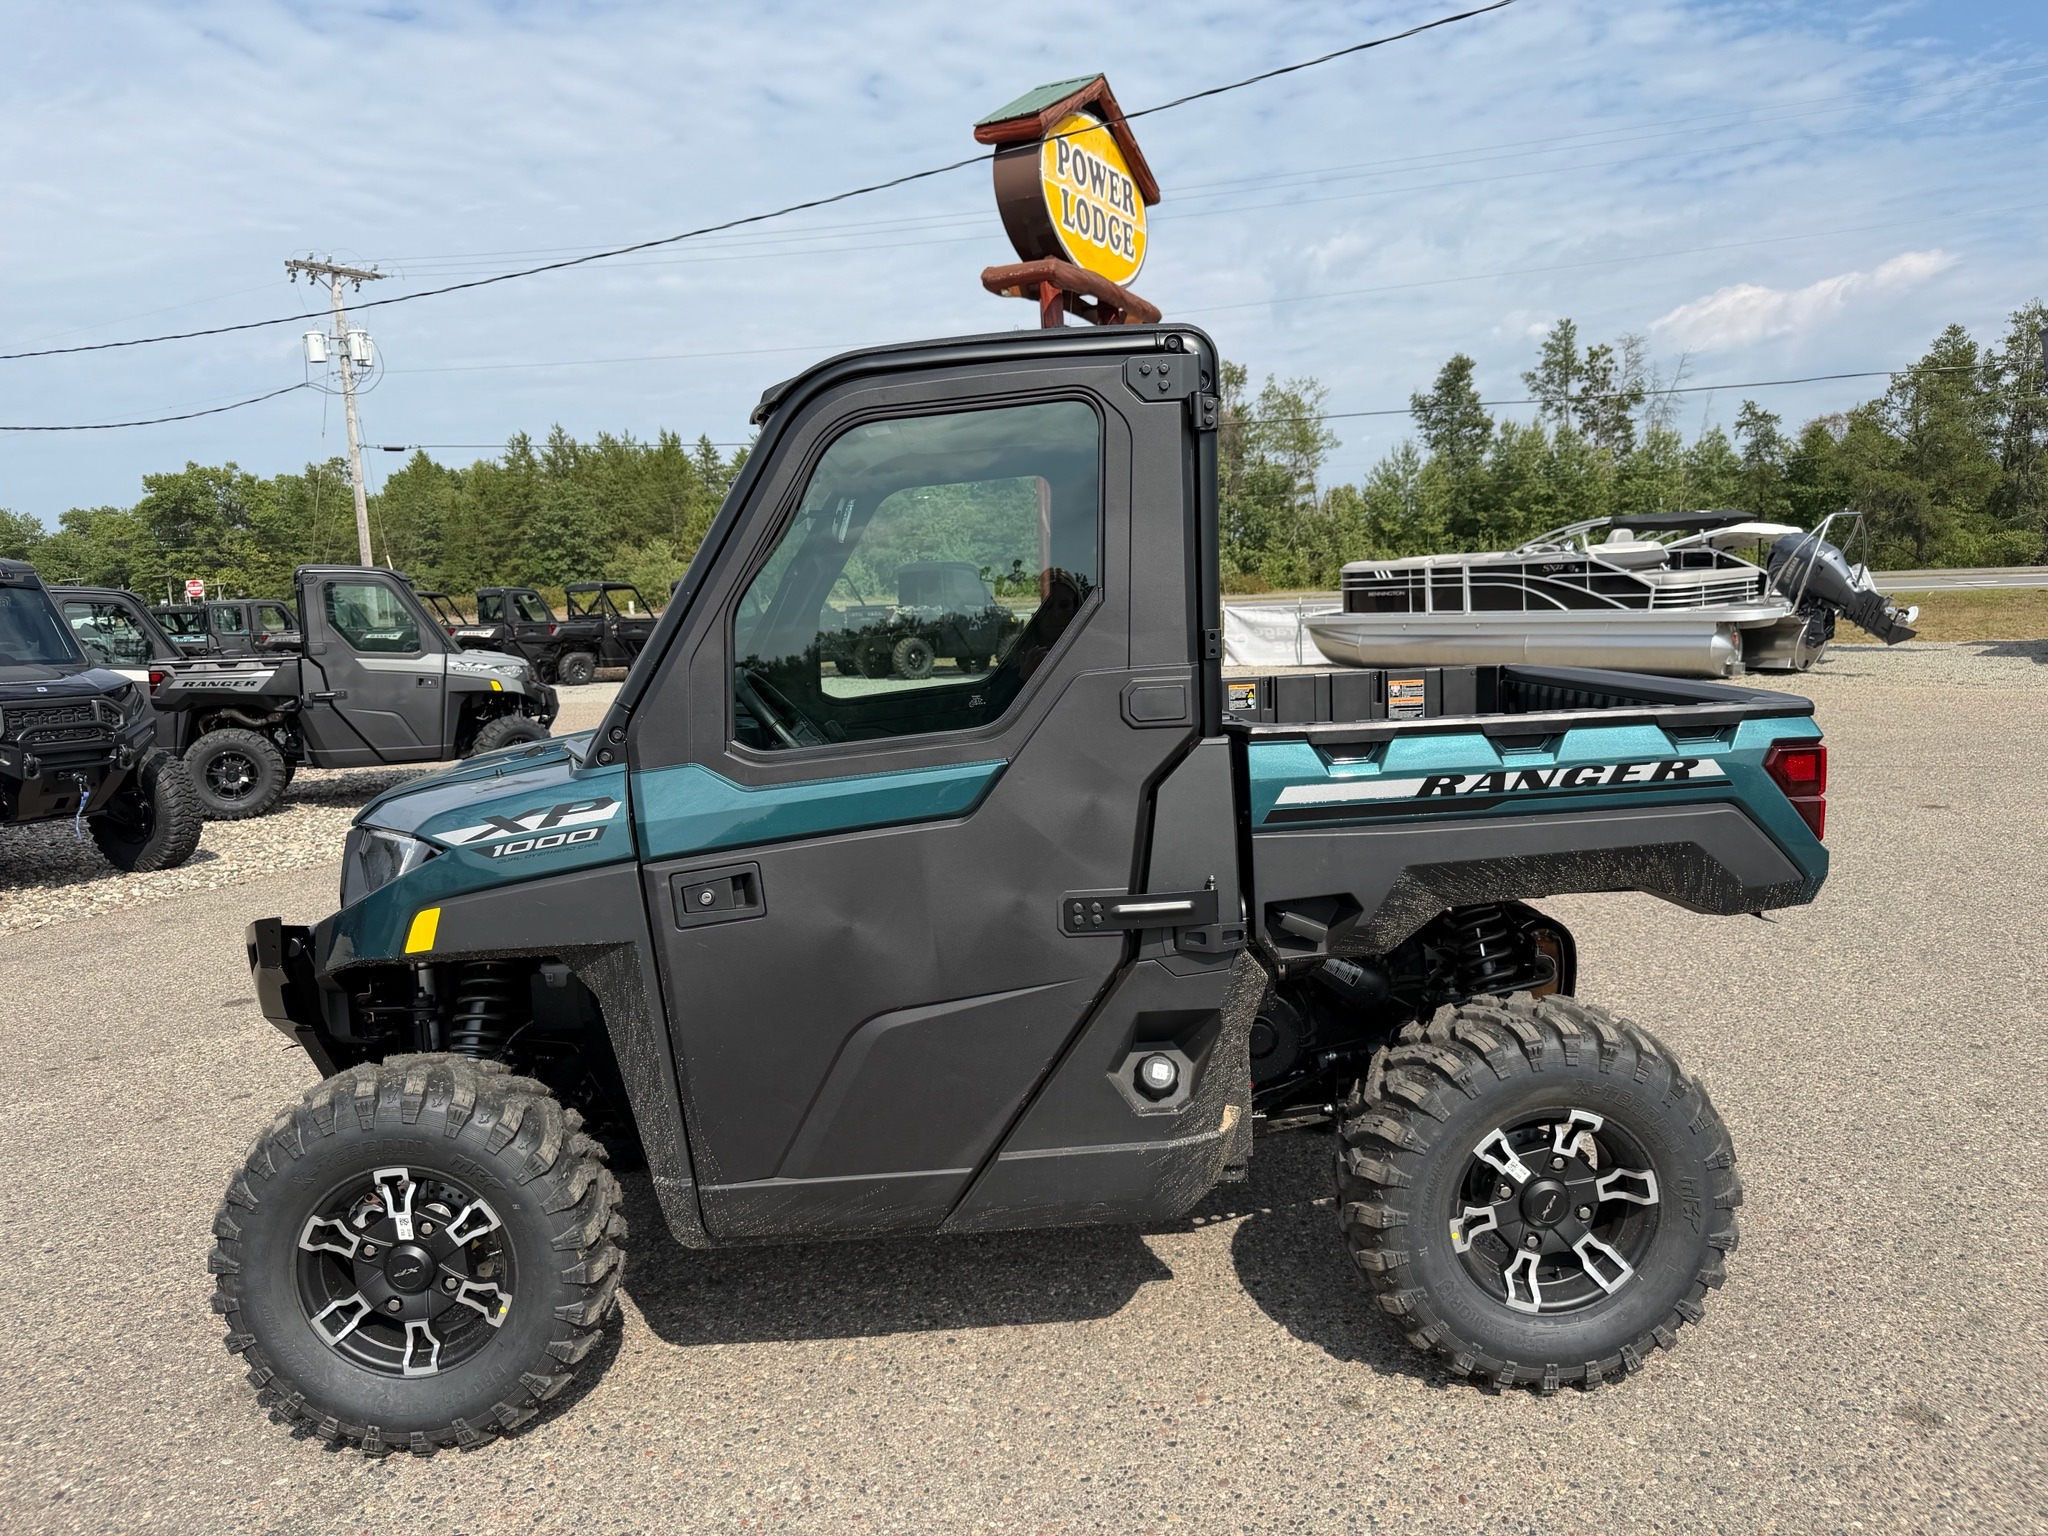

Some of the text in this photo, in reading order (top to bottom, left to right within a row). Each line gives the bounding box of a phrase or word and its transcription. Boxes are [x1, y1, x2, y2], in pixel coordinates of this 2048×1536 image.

[1055, 138, 1136, 218] POWER
[1060, 187, 1135, 260] LODGE
[182, 680, 258, 688] RANGER
[8, 712, 91, 730] POLARIS
[1414, 758, 1700, 799] RANGER
[461, 796, 617, 844] XP
[492, 827, 599, 858] 1000
[497, 842, 600, 865] DUAL OVERHEAD CAM
